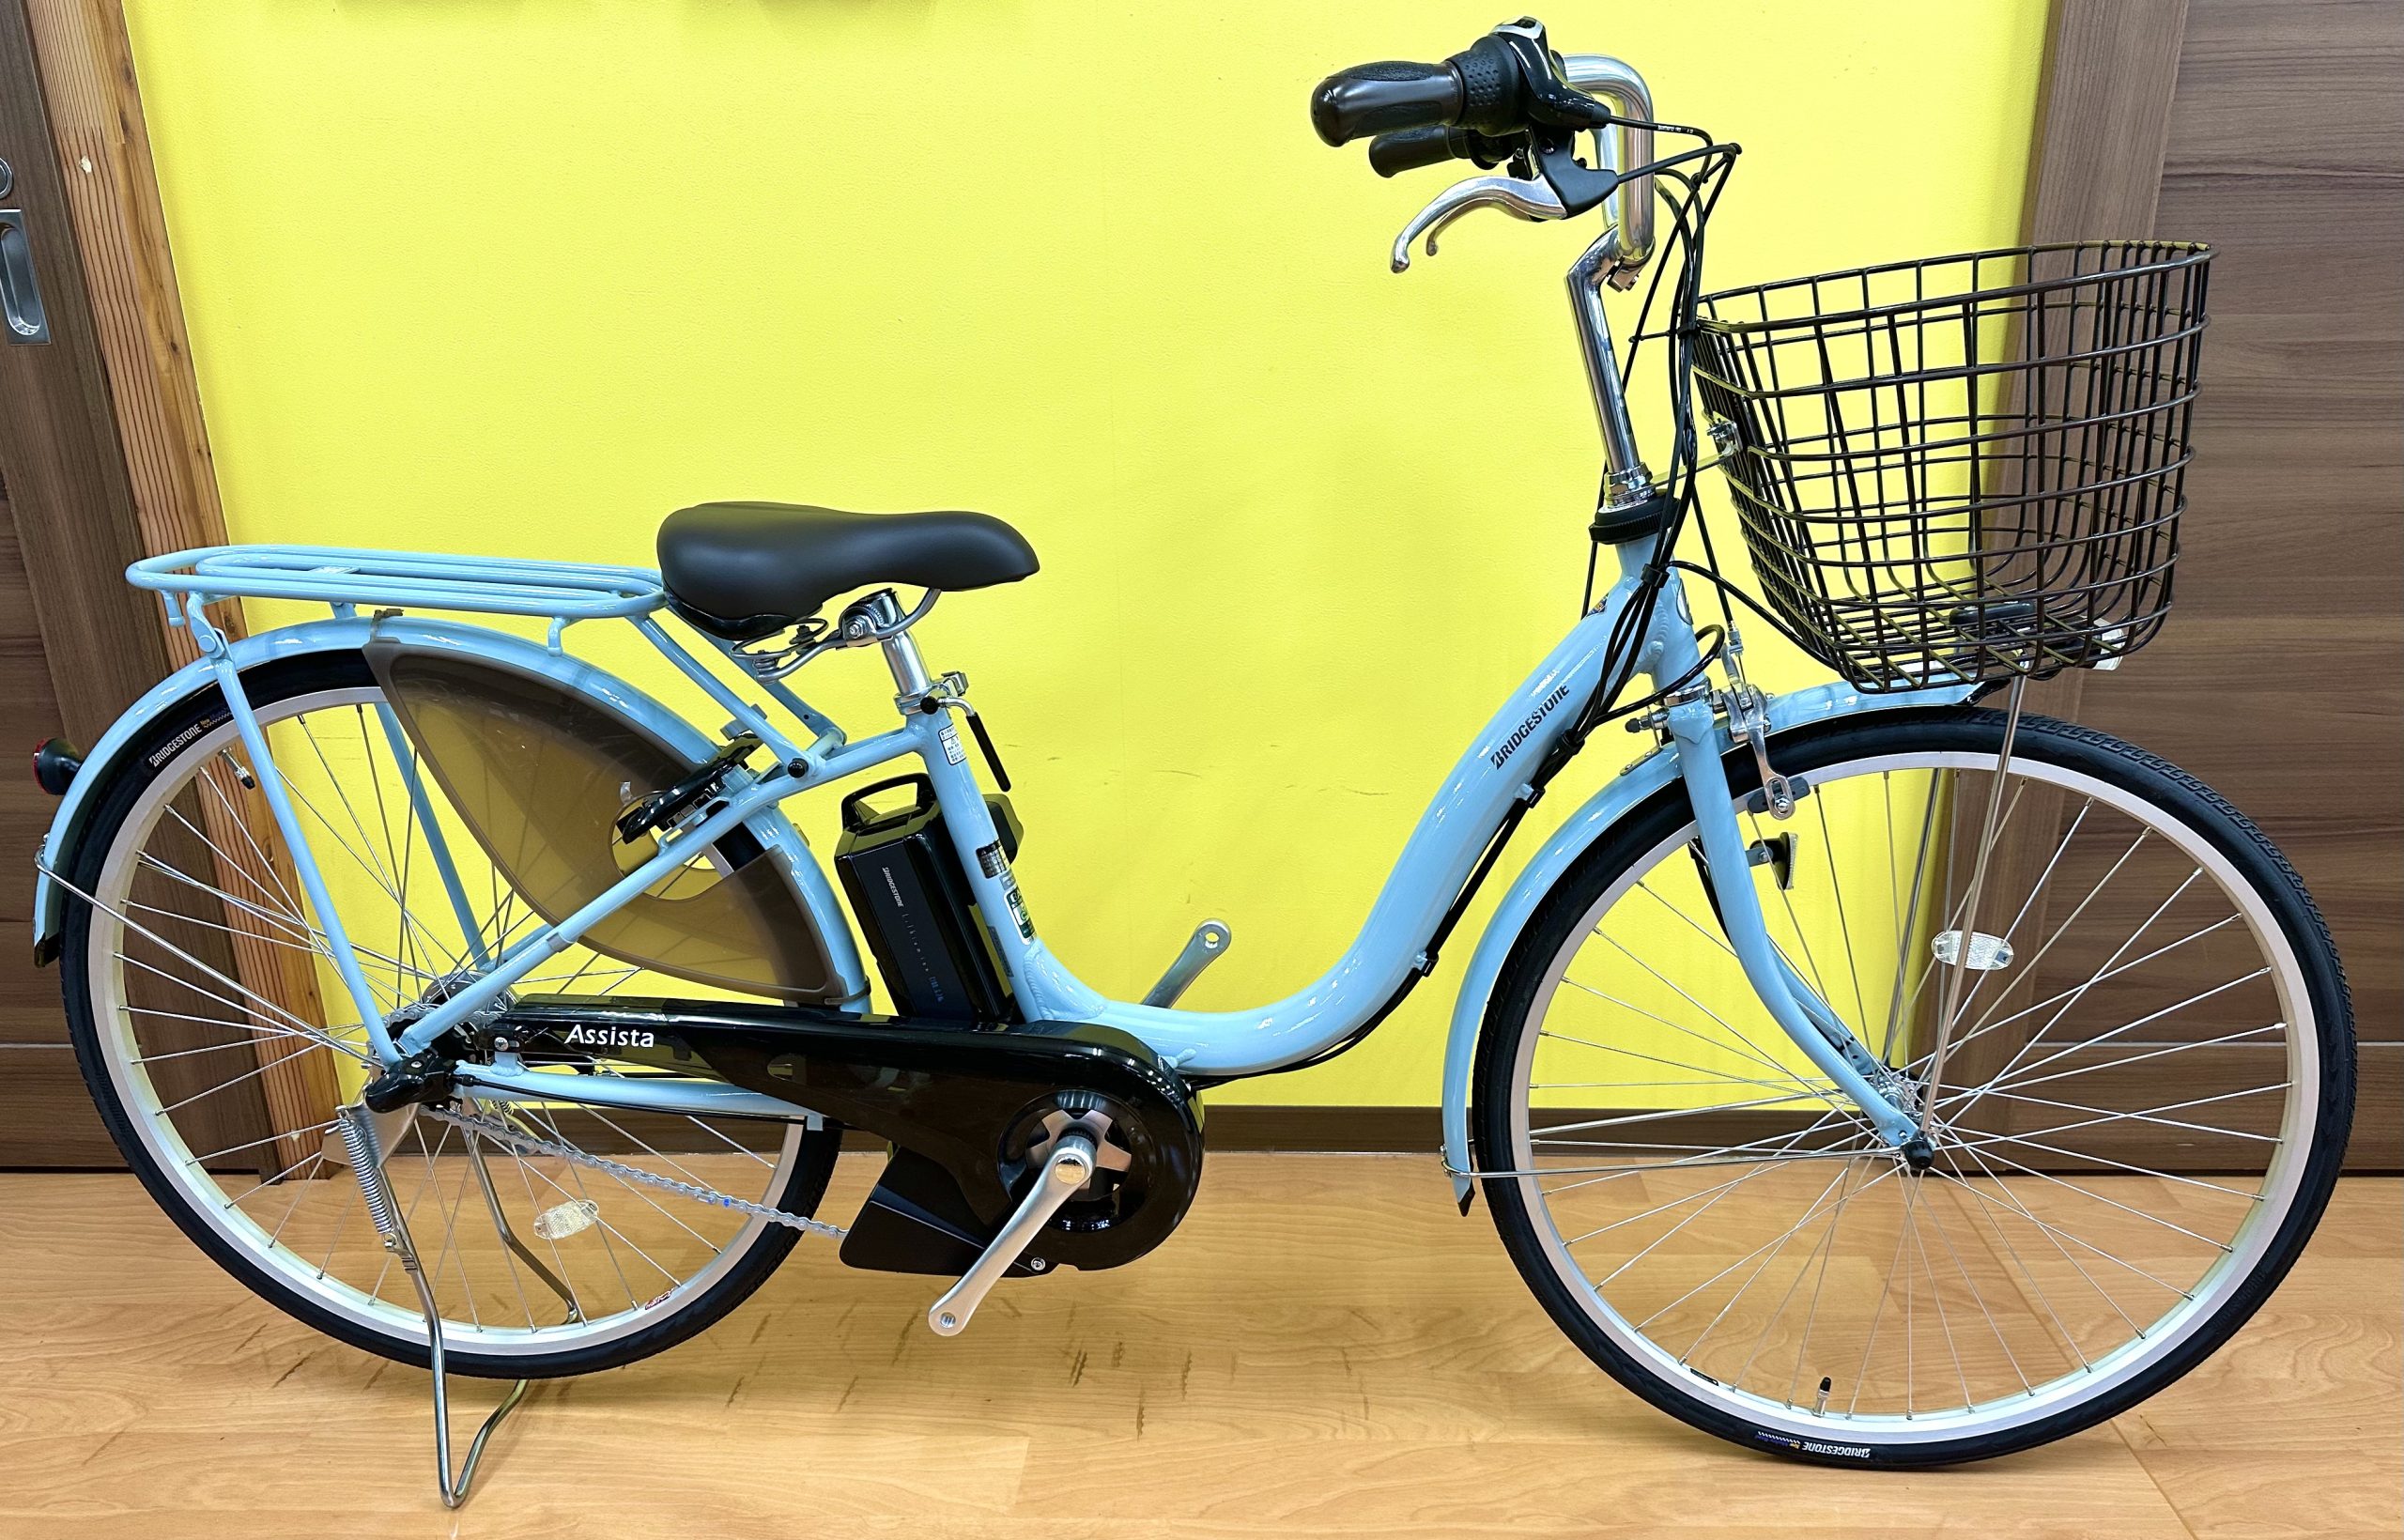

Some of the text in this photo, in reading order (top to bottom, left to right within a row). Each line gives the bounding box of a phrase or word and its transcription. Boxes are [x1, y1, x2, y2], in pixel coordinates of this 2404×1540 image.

[148, 723, 202, 767] BRIDGESTONE
[1490, 685, 1570, 770] BRIDGESTONE
[882, 867, 904, 908] BRIDGESTONE
[563, 1024, 655, 1048] Assista
[1801, 1441, 1871, 1458] BRIDGESTONE
